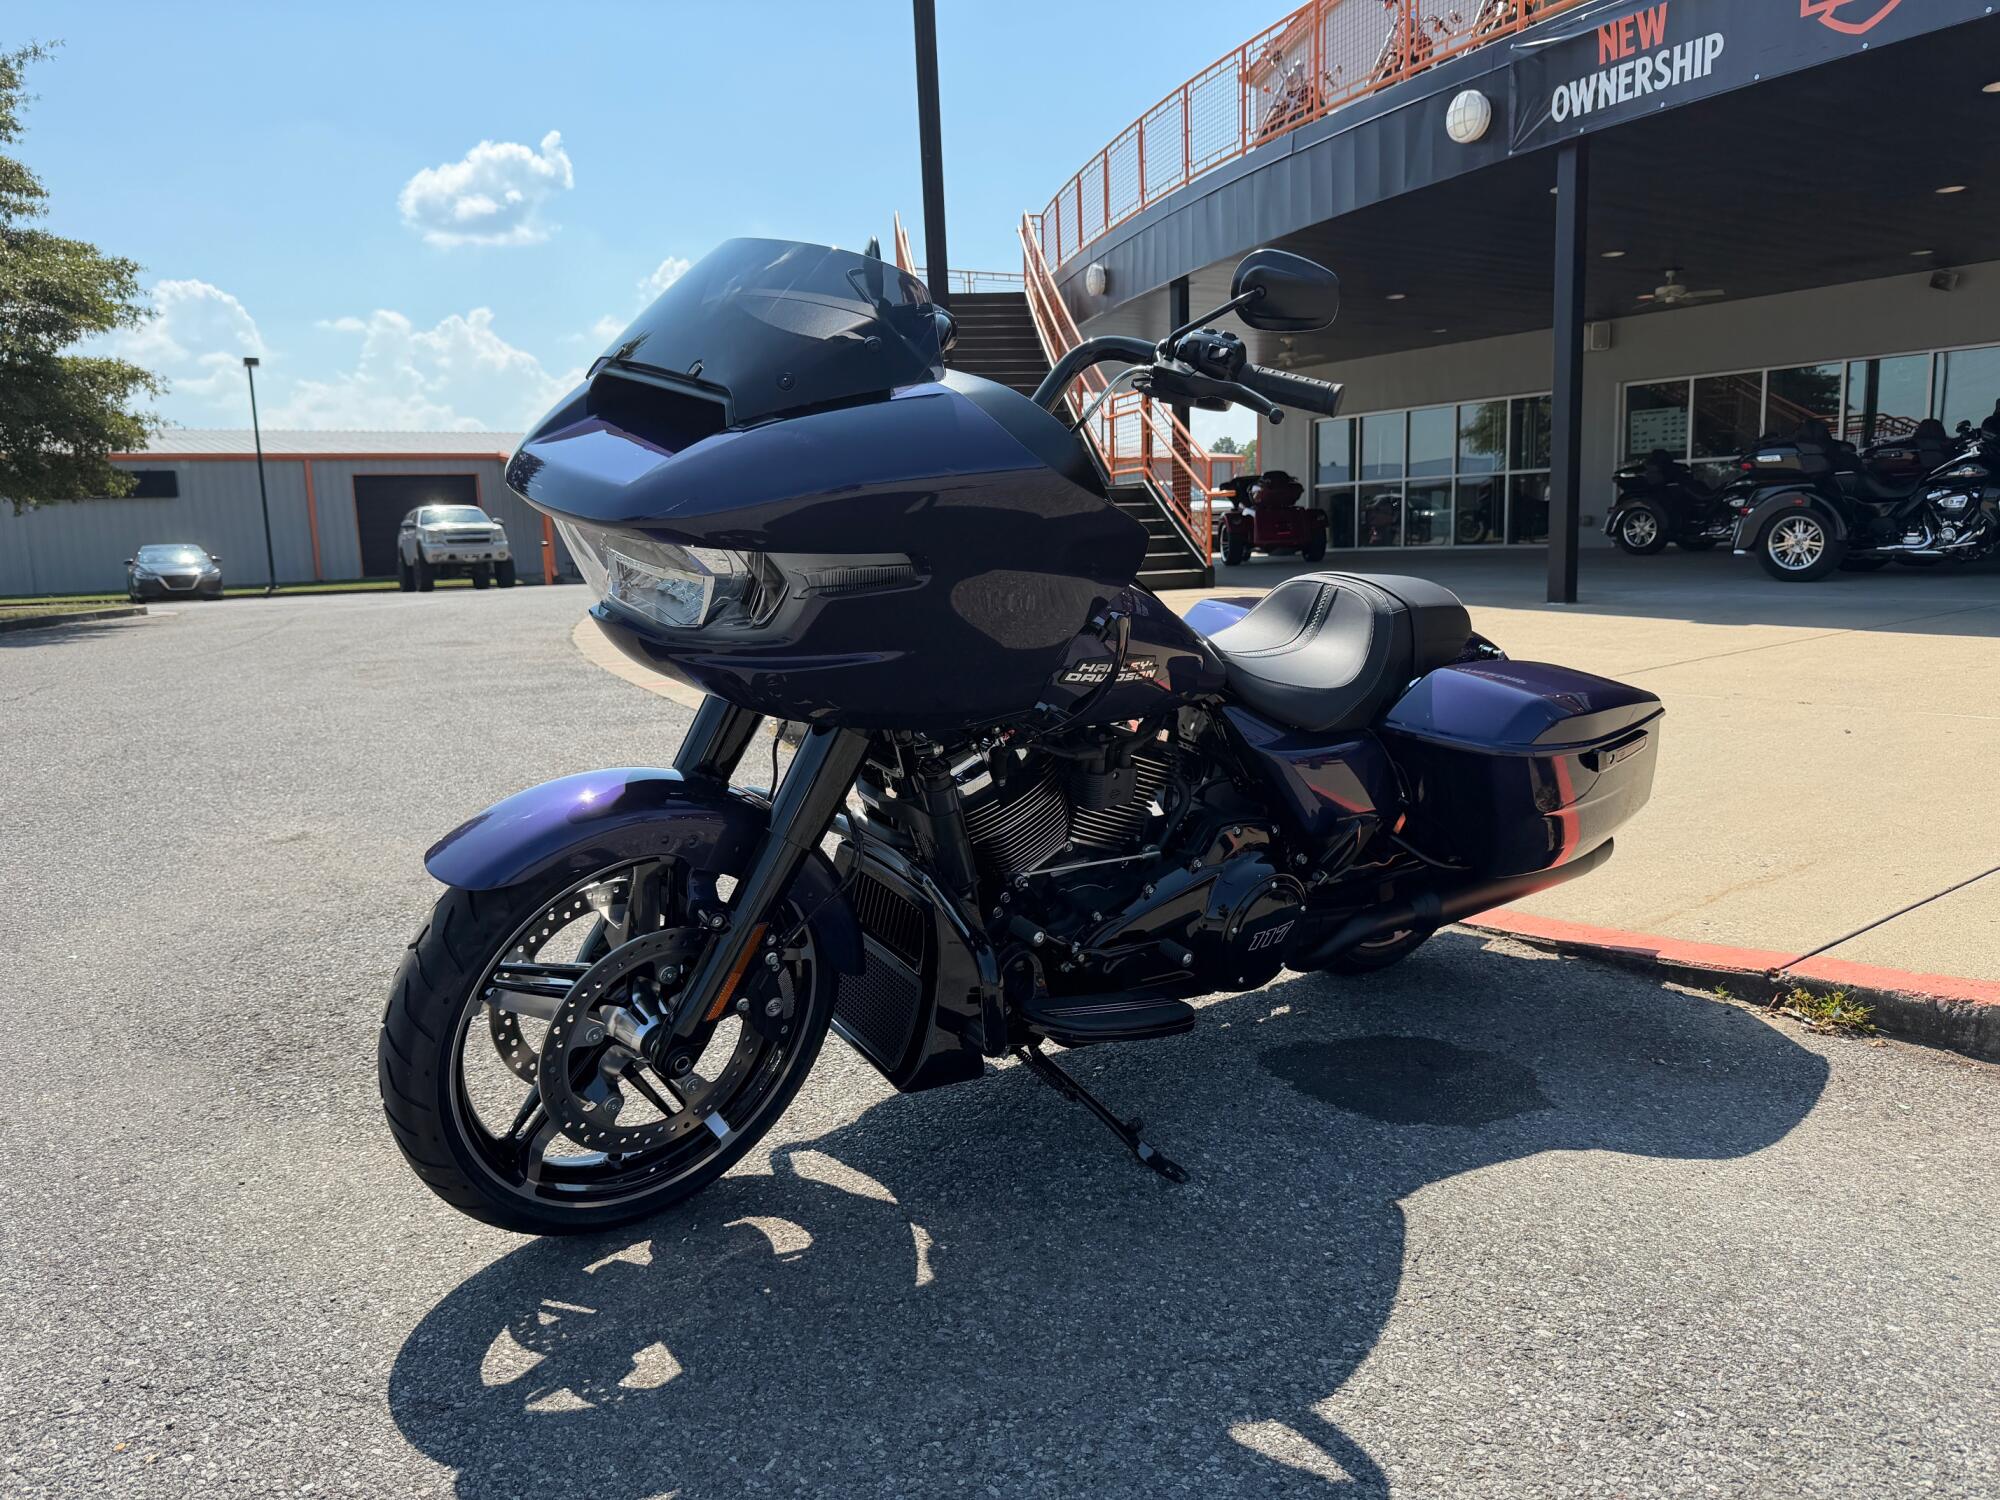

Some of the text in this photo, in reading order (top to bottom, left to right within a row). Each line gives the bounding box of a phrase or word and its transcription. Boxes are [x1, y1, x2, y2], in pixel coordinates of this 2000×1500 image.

[1597, 2, 1667, 65] NEW
[1551, 32, 1725, 123] OWNERSHIP
[1065, 669, 1156, 683] DAVDSON
[1248, 920, 1295, 950] 117
